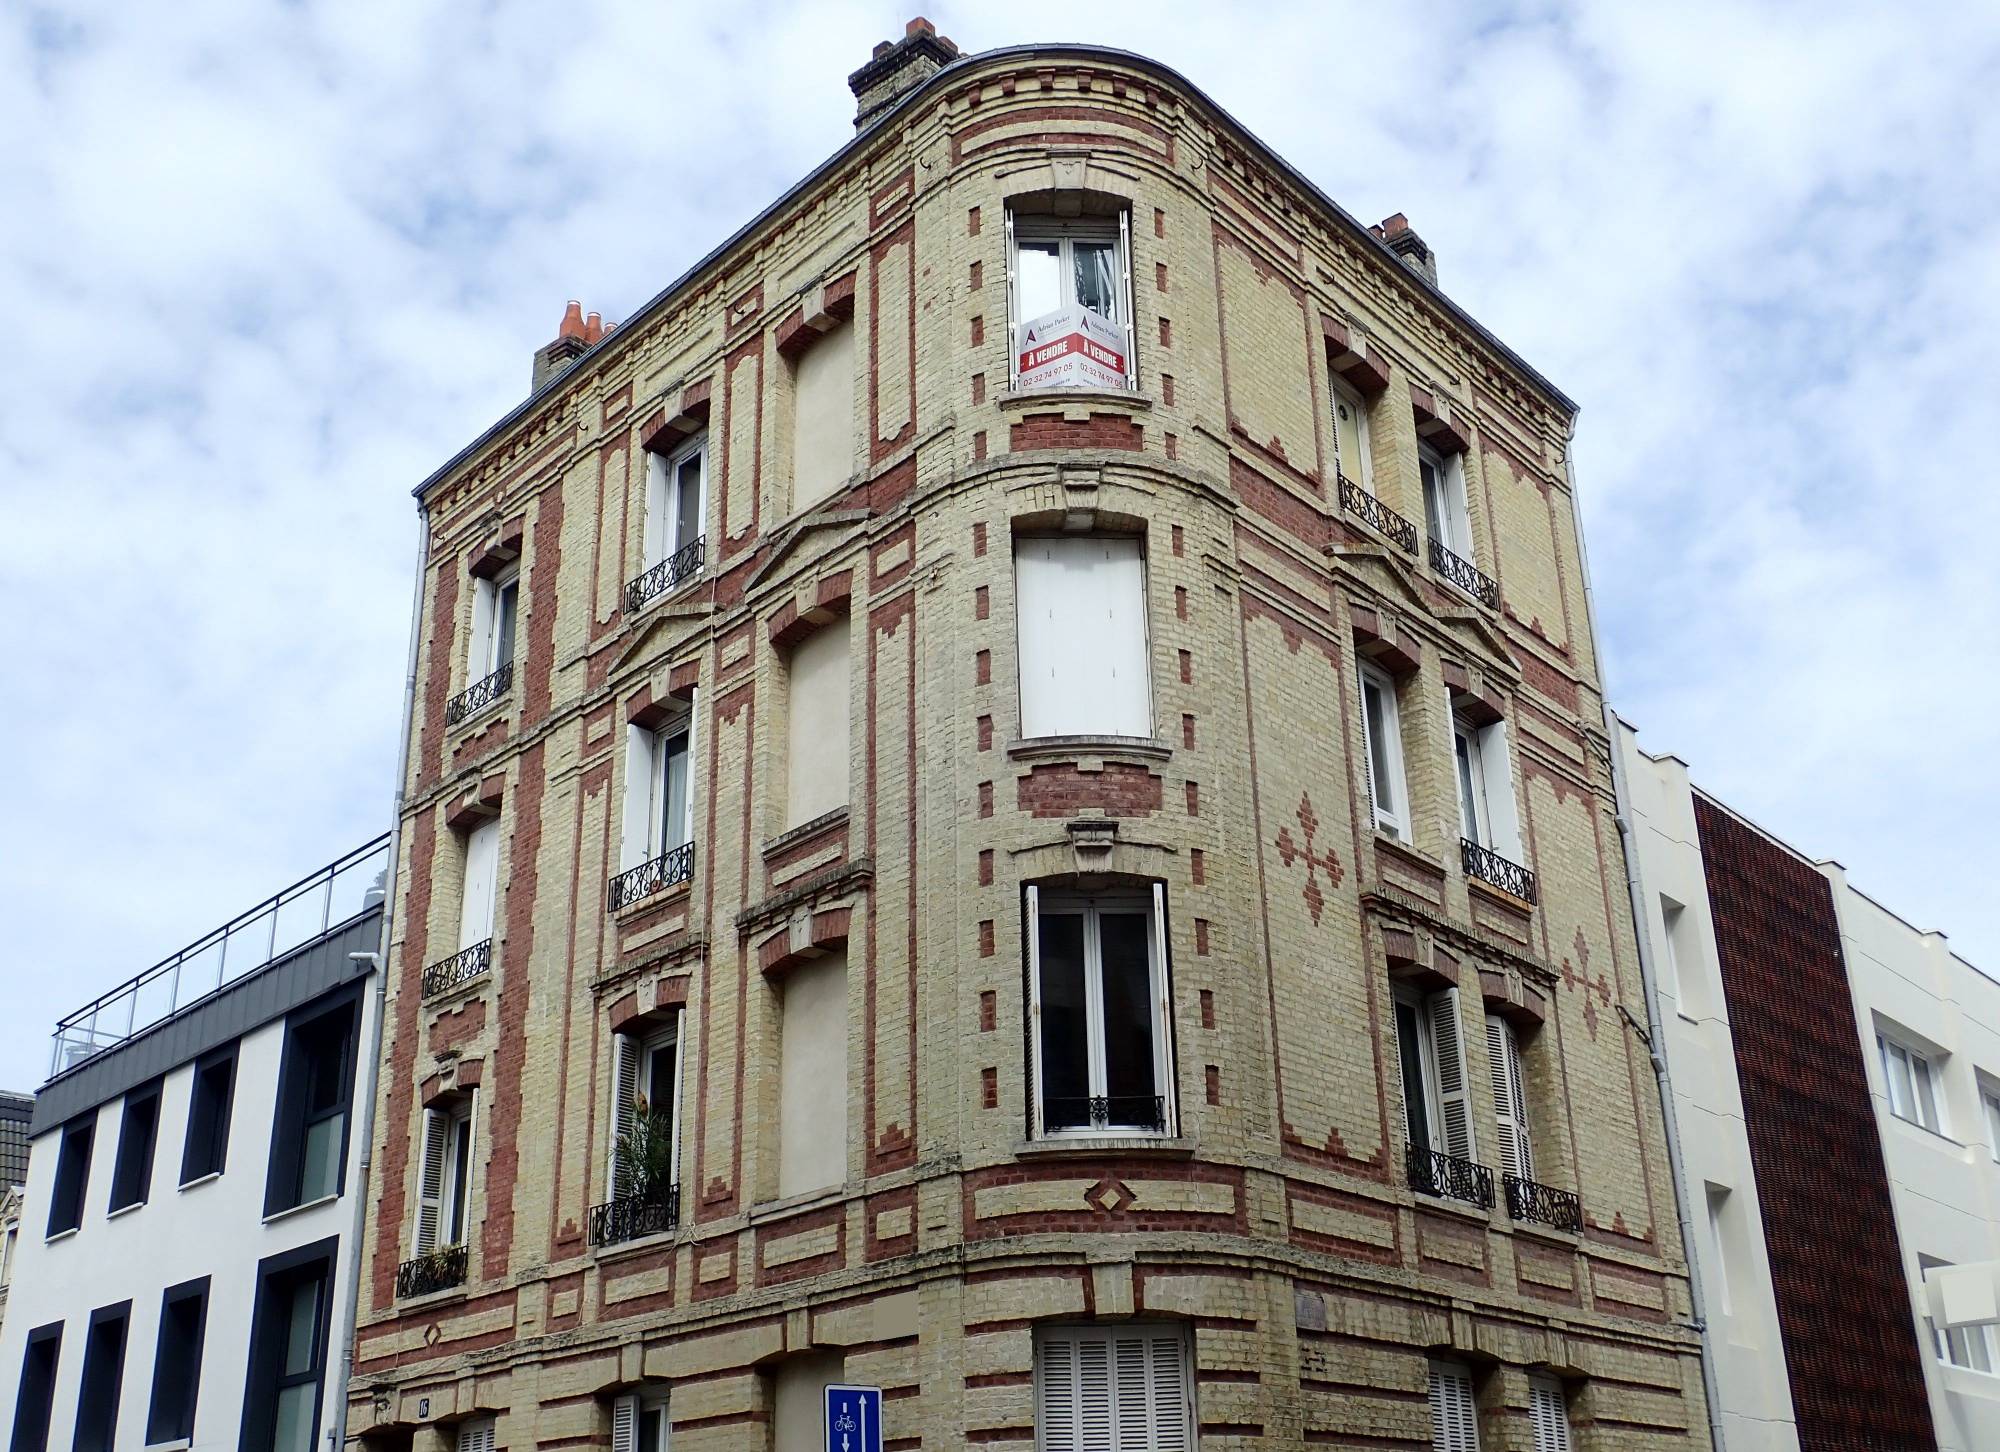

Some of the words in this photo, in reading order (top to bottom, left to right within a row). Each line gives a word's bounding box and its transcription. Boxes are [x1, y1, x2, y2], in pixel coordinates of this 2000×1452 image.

[1036, 341, 1068, 363] VENDRE
[1090, 344, 1117, 368] VENDRE
[1023, 378, 1032, 386] 02
[1034, 374, 1042, 382] 32
[1044, 371, 1052, 379] 74
[1063, 362, 1072, 372] 05
[1080, 363, 1088, 372] 02
[1089, 367, 1097, 376] 32
[1098, 371, 1105, 380] 74
[420, 1400, 428, 1415] 16
